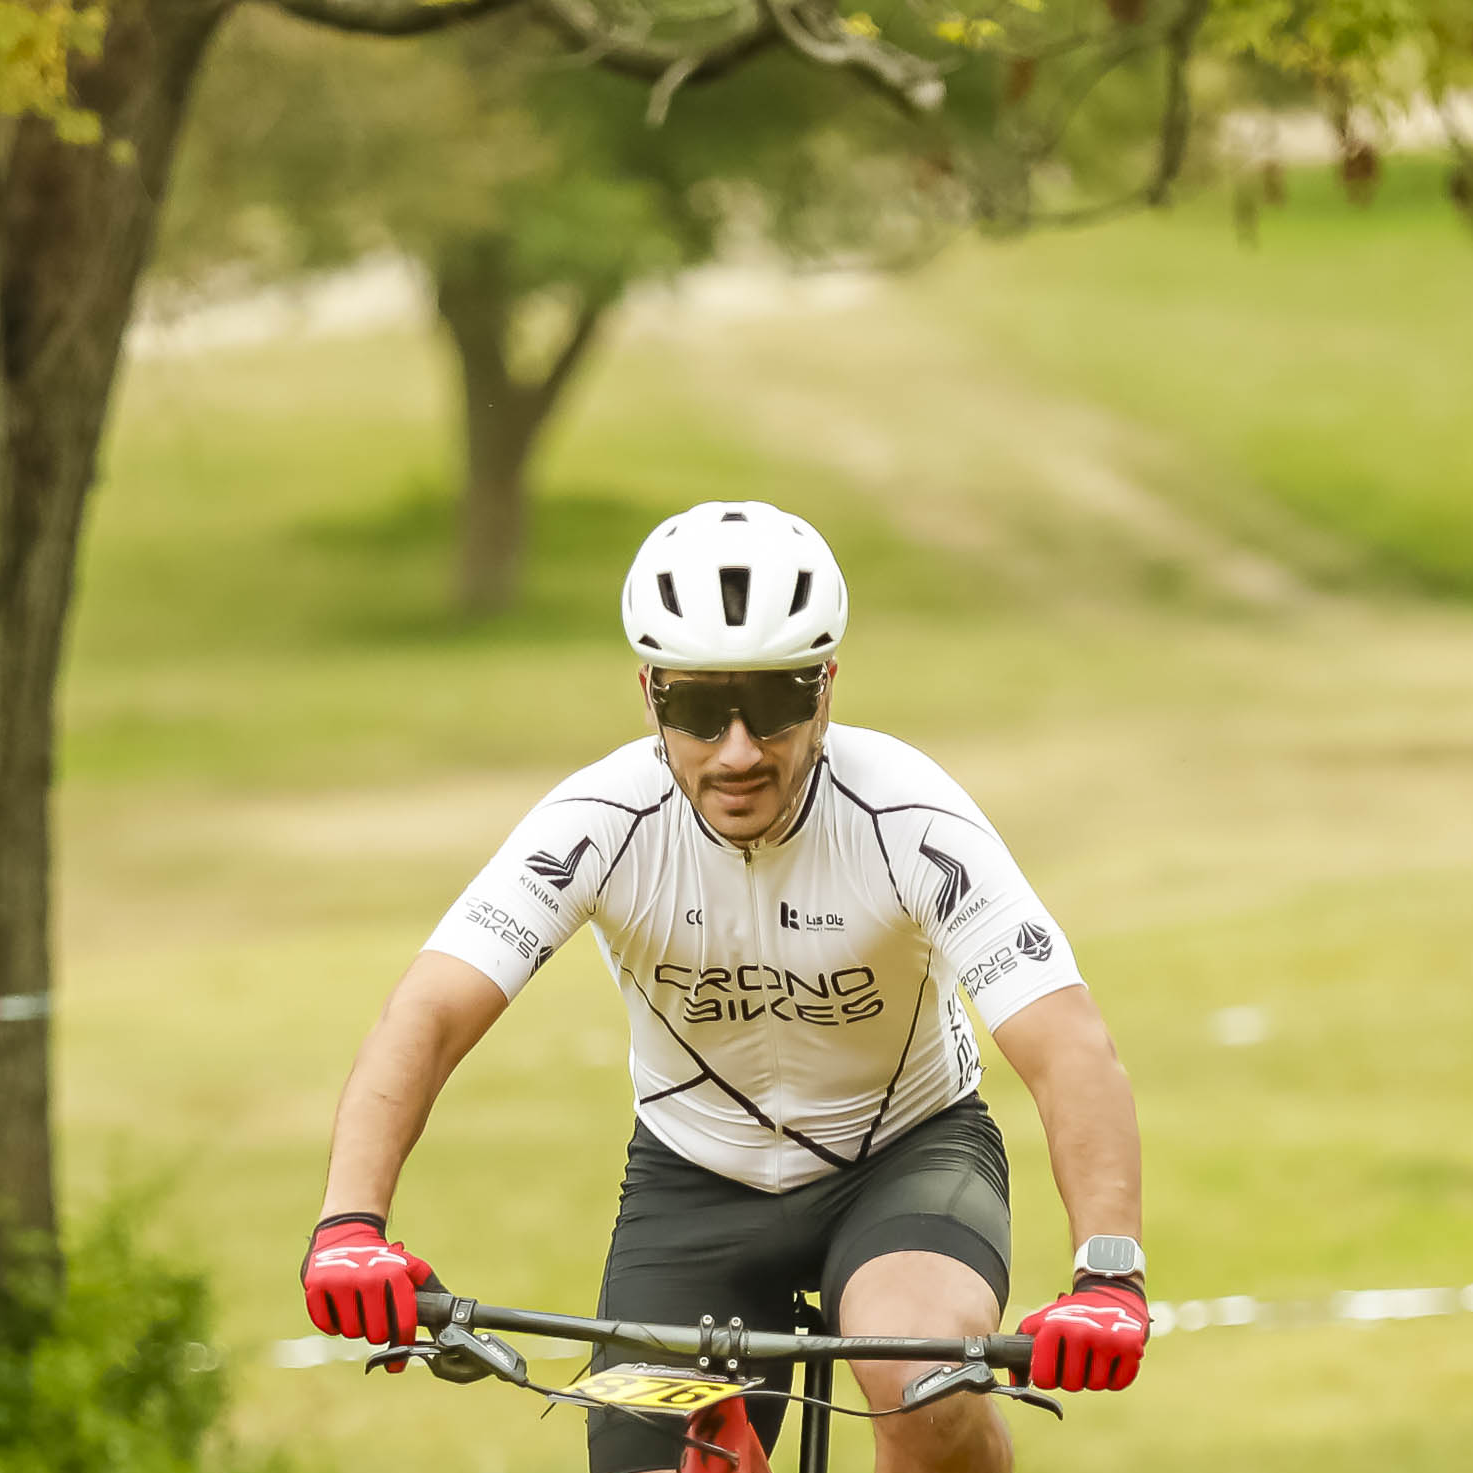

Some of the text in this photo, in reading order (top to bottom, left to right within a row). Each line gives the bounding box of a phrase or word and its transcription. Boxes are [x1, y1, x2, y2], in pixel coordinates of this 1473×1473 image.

[519, 874, 560, 914] KINIMA
[466, 909, 533, 959] BIKES
[947, 897, 989, 933] KINIMA
[654, 964, 875, 999] CRONO
[960, 946, 1012, 986] RONO
[967, 956, 1018, 1002] IKES
[683, 990, 884, 1026] BIKES
